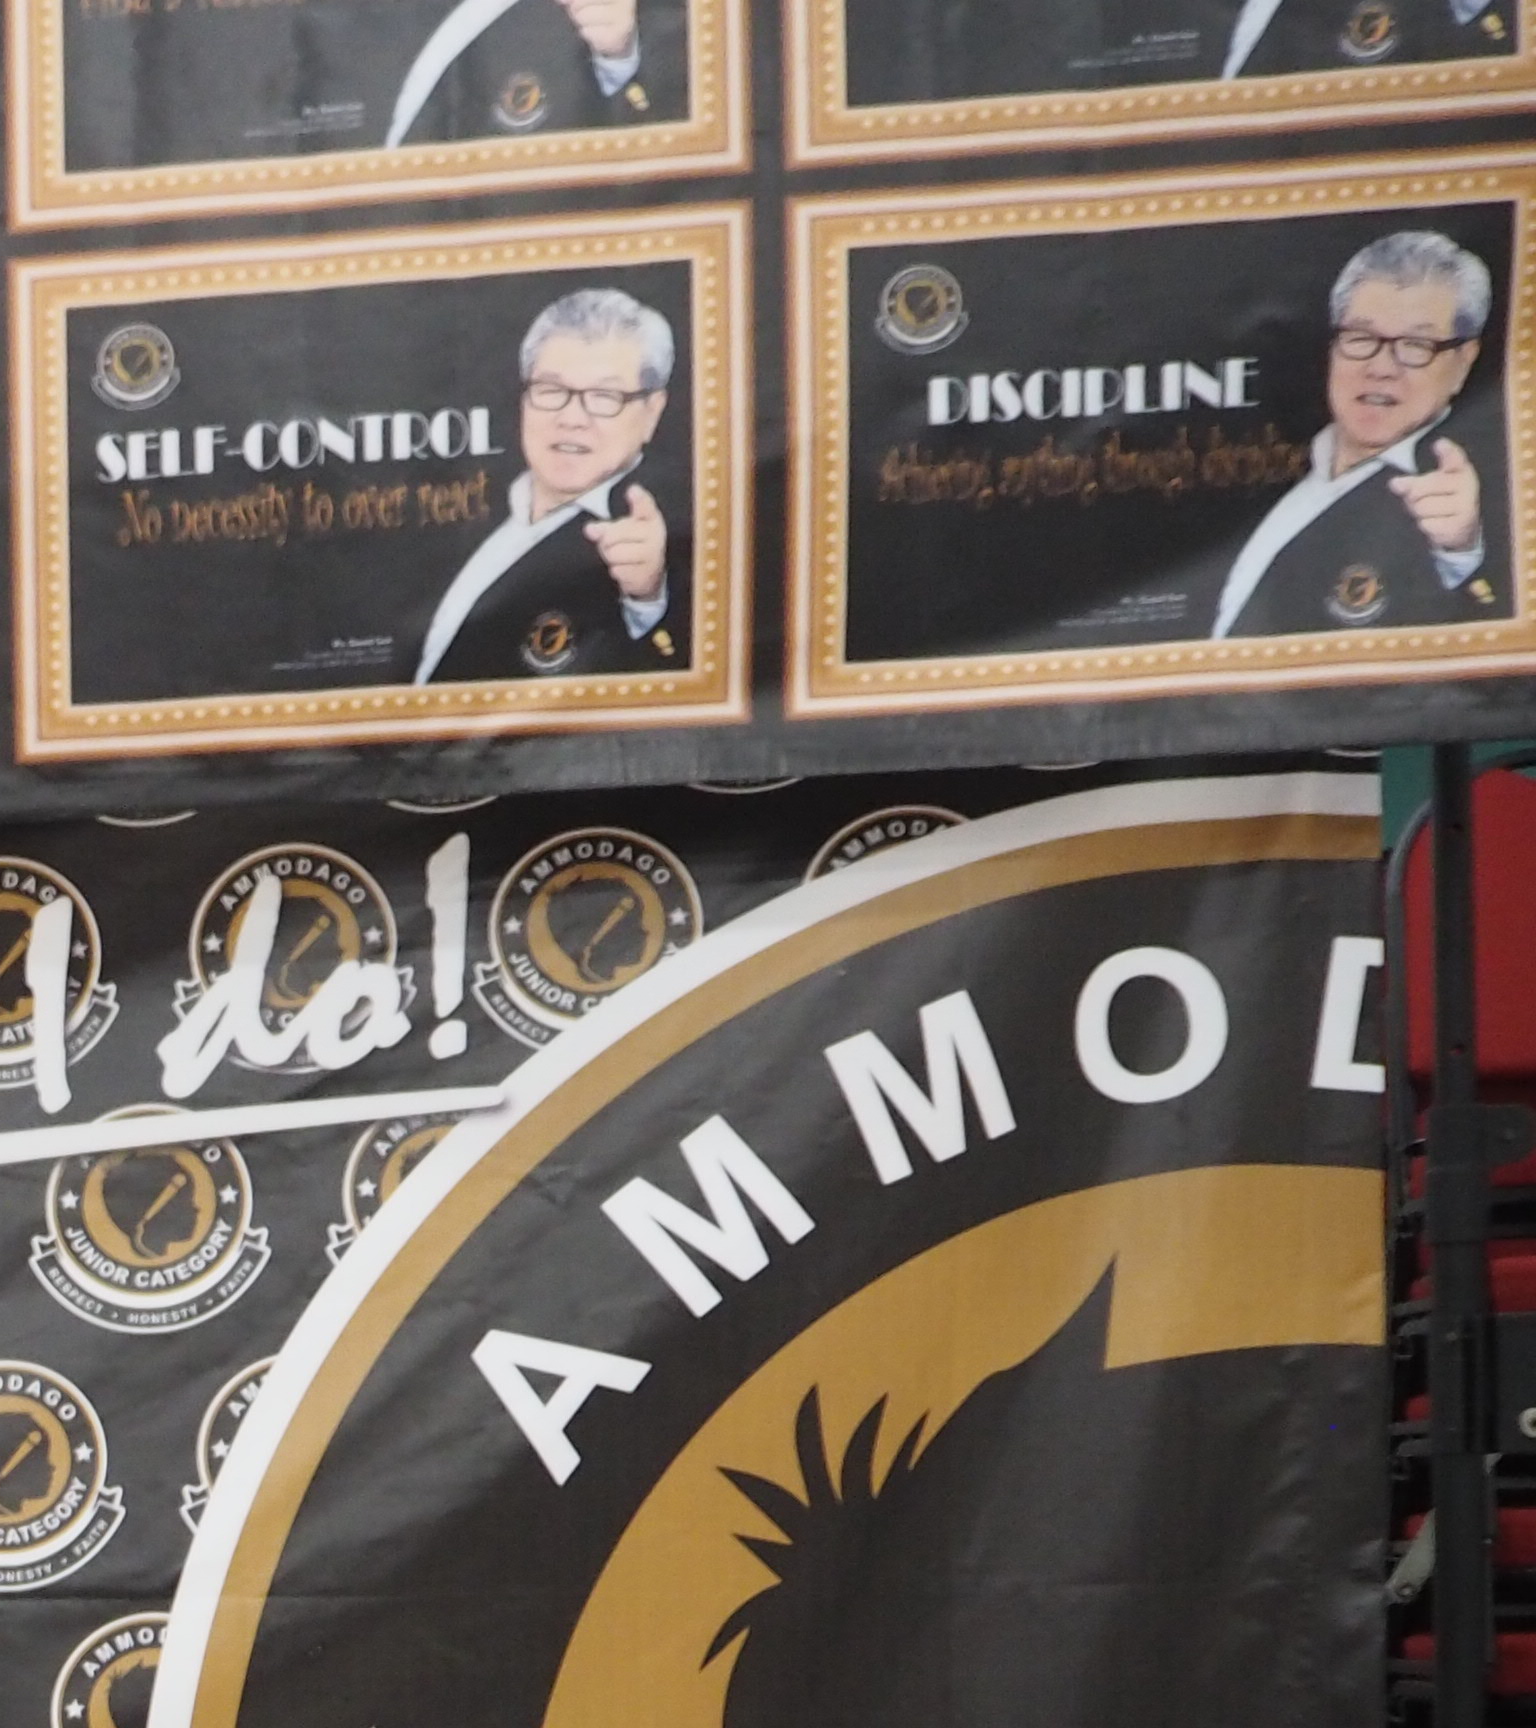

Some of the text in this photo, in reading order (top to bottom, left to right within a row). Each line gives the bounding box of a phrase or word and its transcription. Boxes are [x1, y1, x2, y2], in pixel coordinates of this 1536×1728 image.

[928, 357, 1261, 426] DISCIPLINE
[95, 406, 505, 483] SELF-CONTROL
[521, 842, 671, 895] AMMODAGO
[157, 833, 469, 1098] do!
[65, 1218, 232, 1288] JUNIOR CATEGORY
[128, 1305, 198, 1324] HONESTY
